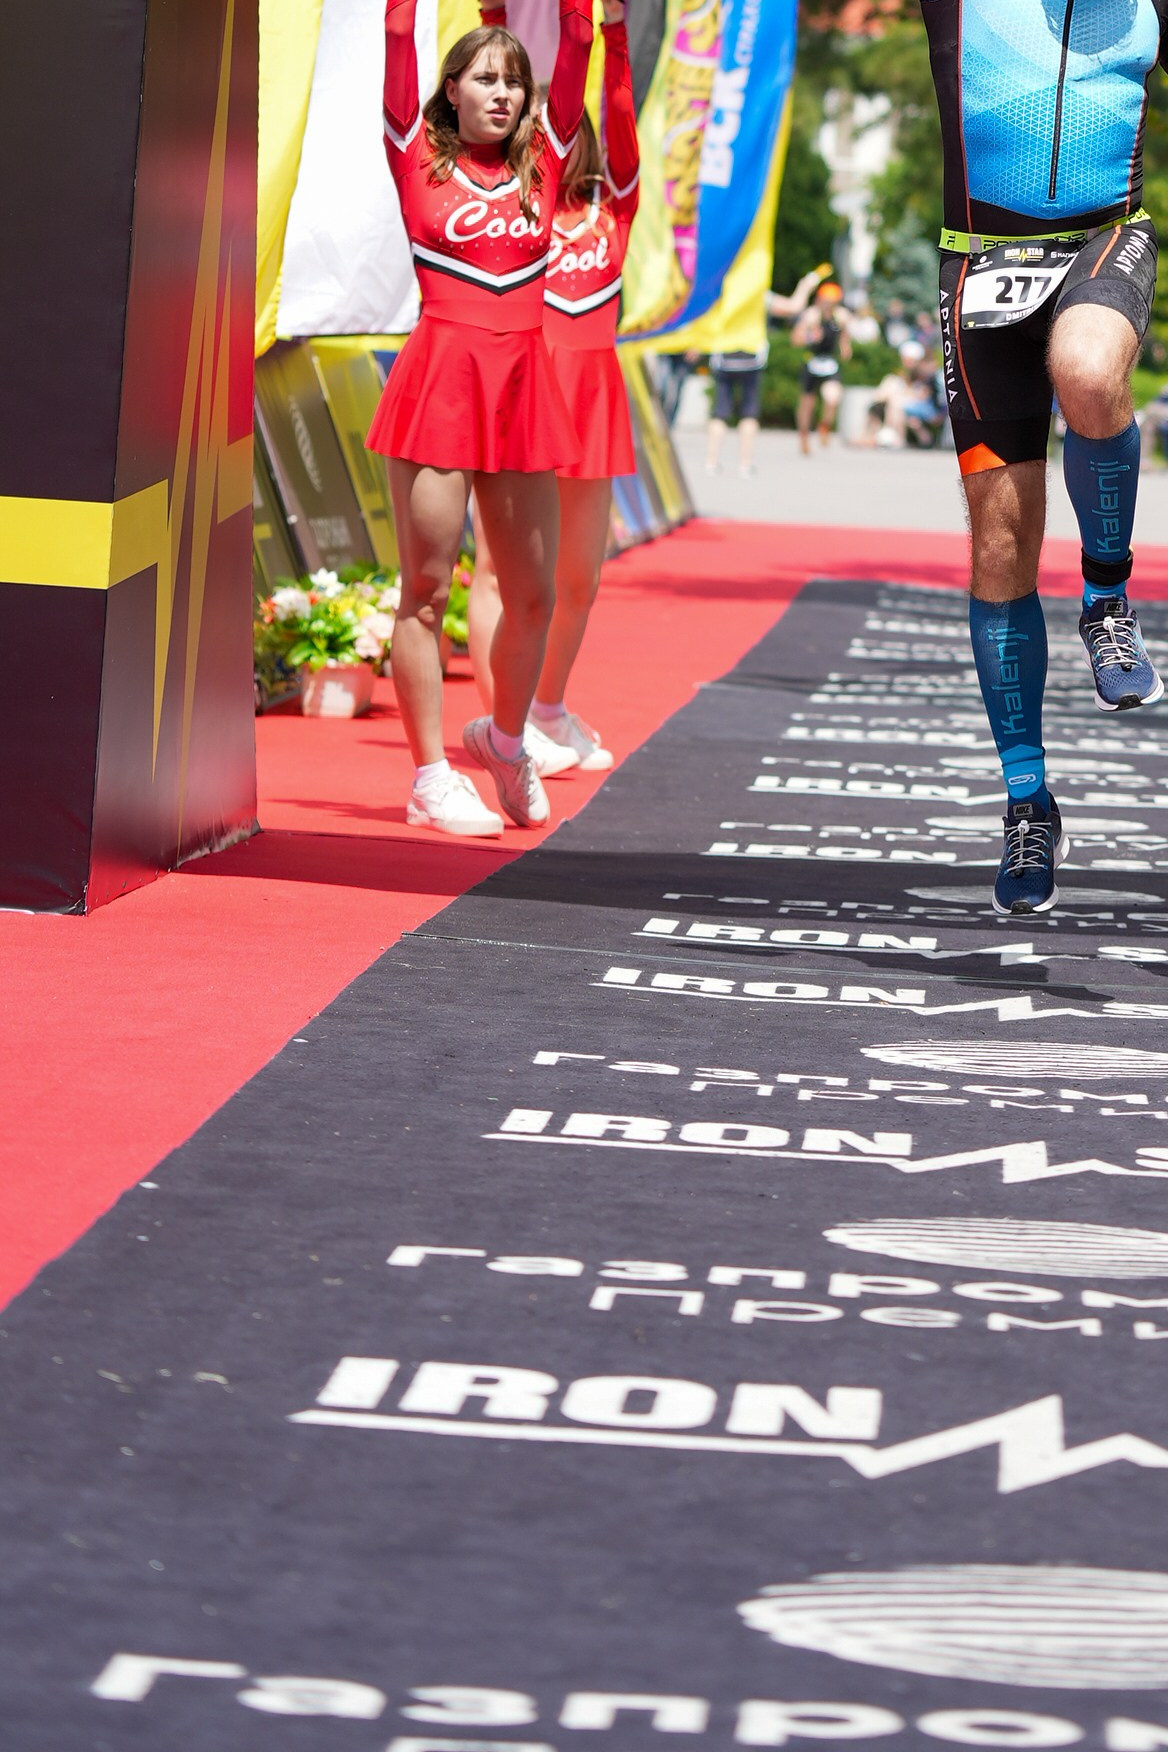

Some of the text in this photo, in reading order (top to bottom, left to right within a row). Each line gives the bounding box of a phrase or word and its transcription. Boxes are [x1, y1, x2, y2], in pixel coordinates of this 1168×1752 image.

[995, 275, 1053, 304] 277
[940, 289, 959, 404] APTONIA
[1015, 804, 1032, 817] NIKE
[642, 917, 938, 950] IRON
[602, 966, 926, 1005] IRON
[500, 1108, 913, 1157] IRON
[315, 1356, 884, 1441] IRON
